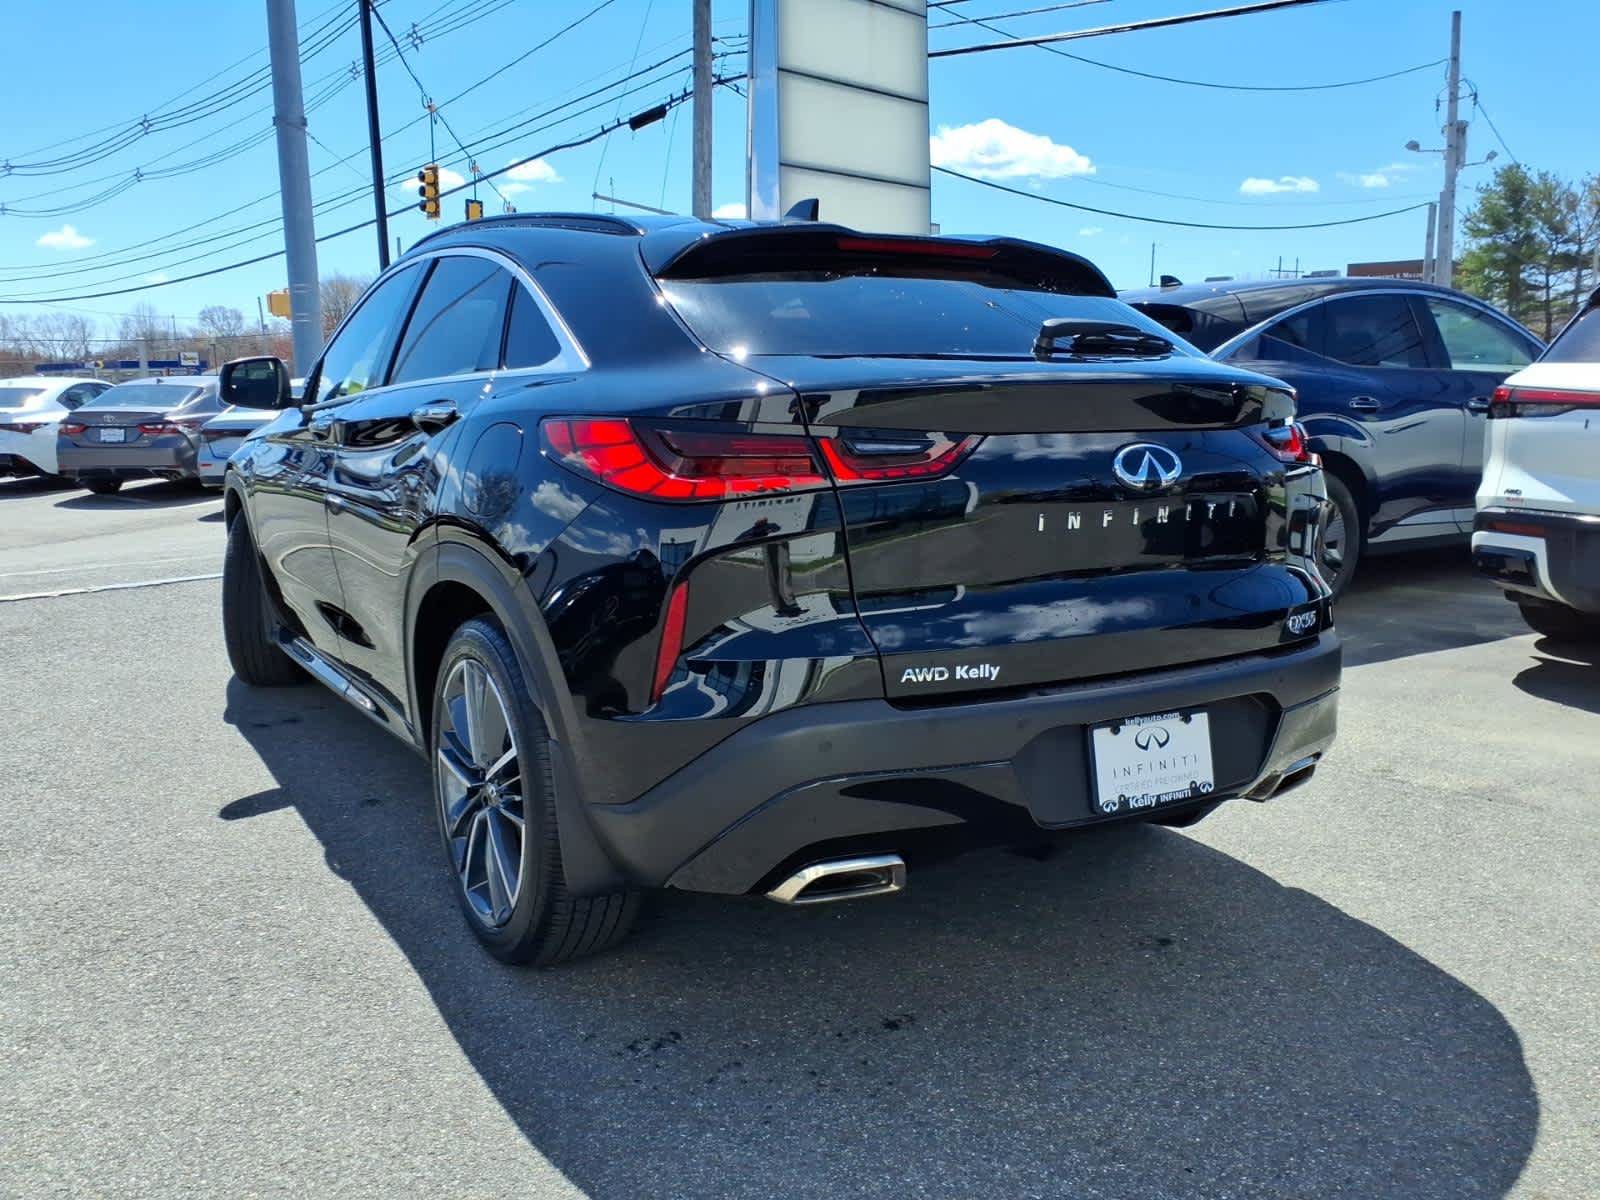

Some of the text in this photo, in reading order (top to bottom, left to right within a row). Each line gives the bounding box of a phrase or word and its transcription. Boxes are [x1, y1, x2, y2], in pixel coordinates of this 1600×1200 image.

[1037, 501, 1236, 531] INFINITI
[1287, 610, 1317, 634] QX55
[901, 664, 1000, 683] AWD Kelly
[1112, 754, 1198, 778] INFINITI
[1129, 789, 1192, 808] Kelly INFINITI
